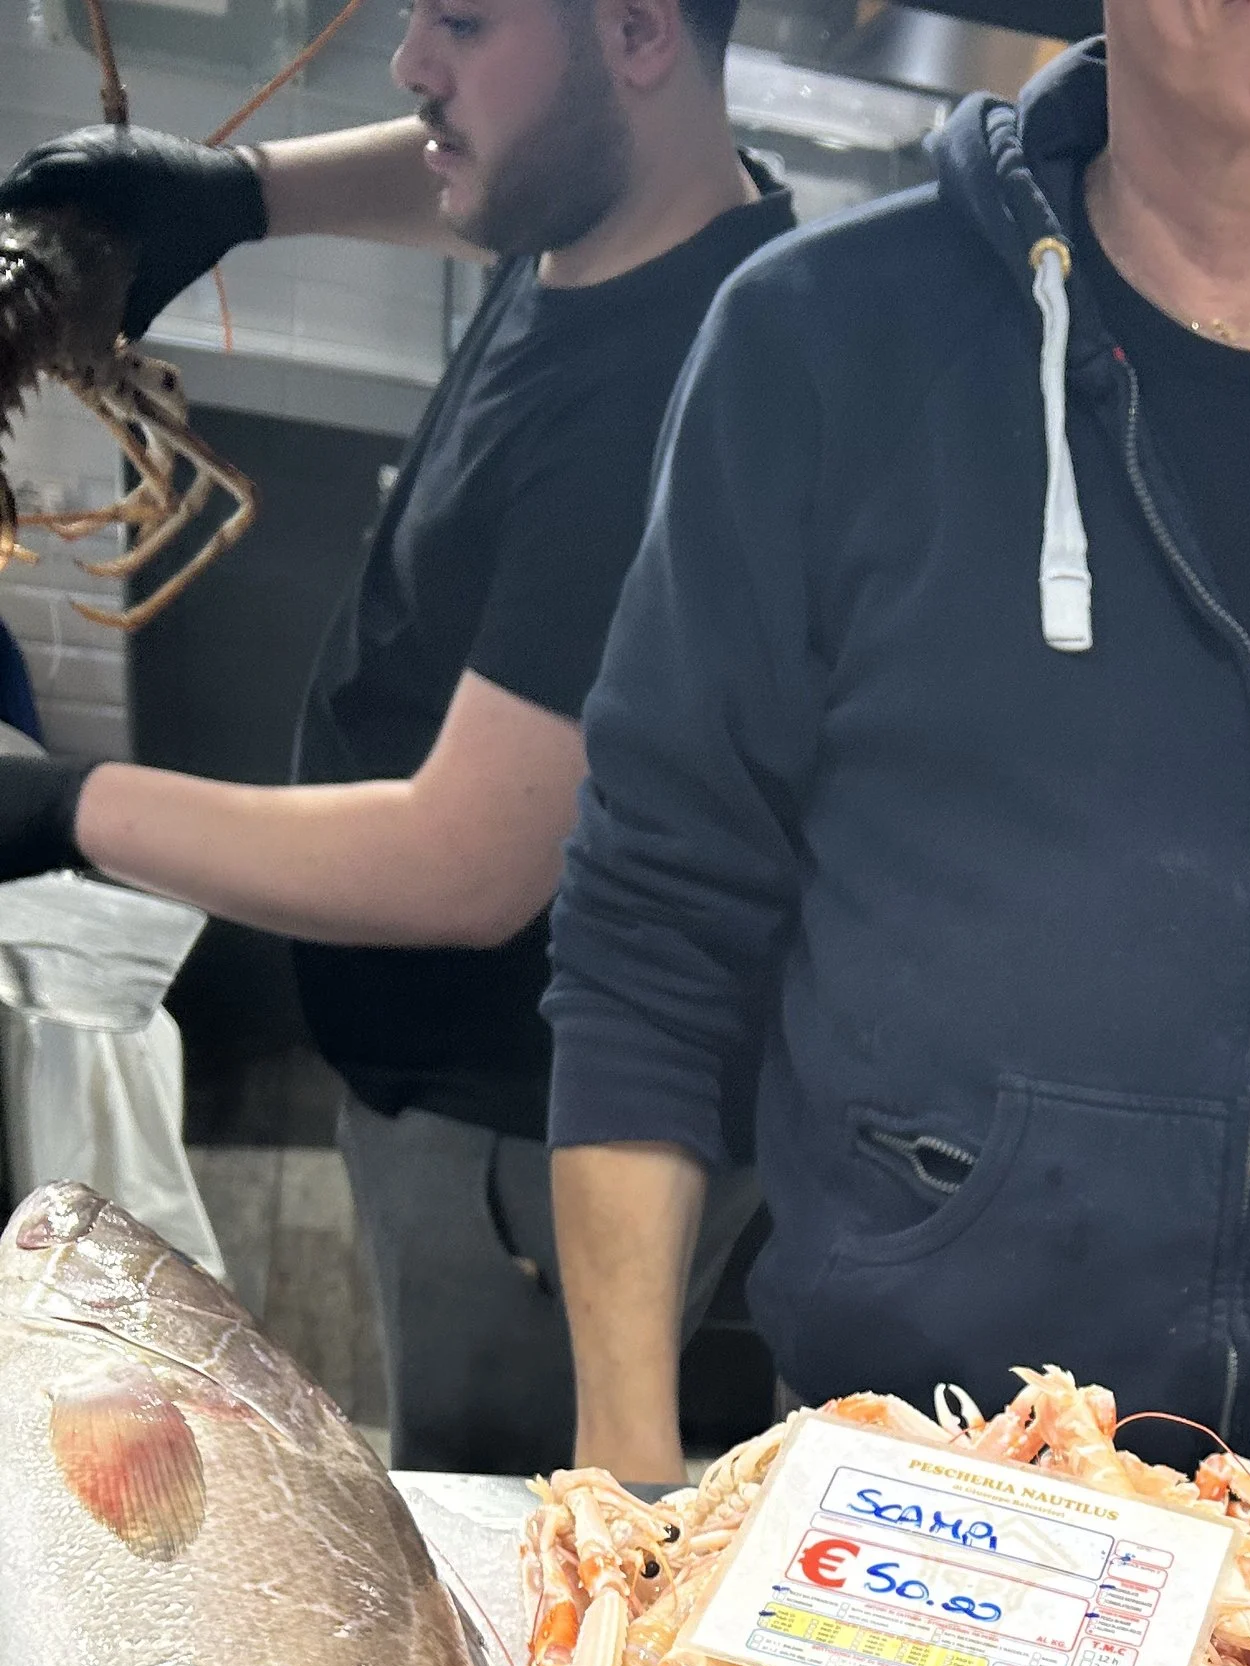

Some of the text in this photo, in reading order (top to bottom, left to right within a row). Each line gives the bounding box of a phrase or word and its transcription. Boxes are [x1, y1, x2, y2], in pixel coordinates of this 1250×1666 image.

[908, 1459, 1121, 1521] PESCHERIA NAUTILUS
[847, 1488, 998, 1552] SCAMPI
[798, 1538, 861, 1588] €
[1098, 1655, 1111, 1664] 12
